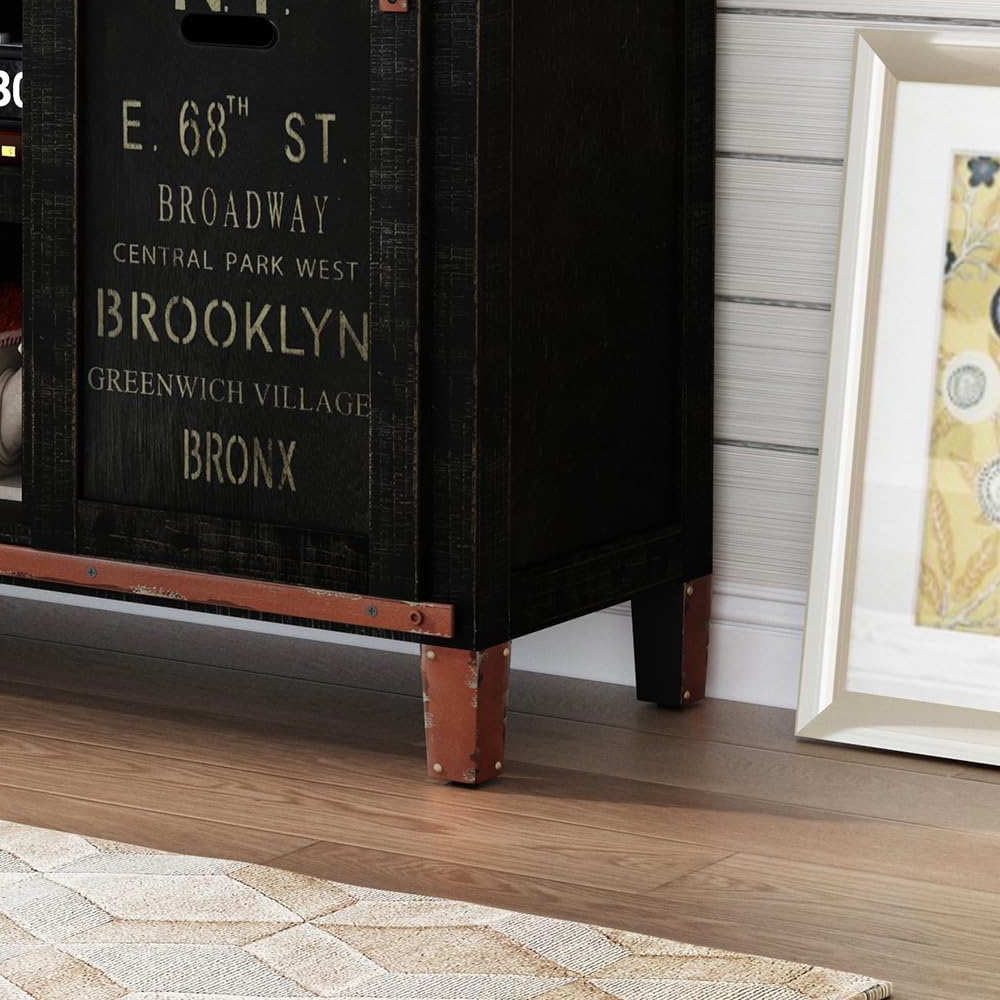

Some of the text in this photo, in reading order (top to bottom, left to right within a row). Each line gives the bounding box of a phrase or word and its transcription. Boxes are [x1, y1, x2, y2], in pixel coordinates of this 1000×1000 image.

[122, 99, 158, 152] E.
[283, 112, 348, 164] ST.
[158, 183, 329, 234] BROADWAY
[113, 242, 359, 281] CENTRAL PARK WEST
[96, 287, 370, 362] BROOKLYN
[87, 366, 372, 418] GREENWICH VILLAGE
[183, 428, 298, 493] BRONX
